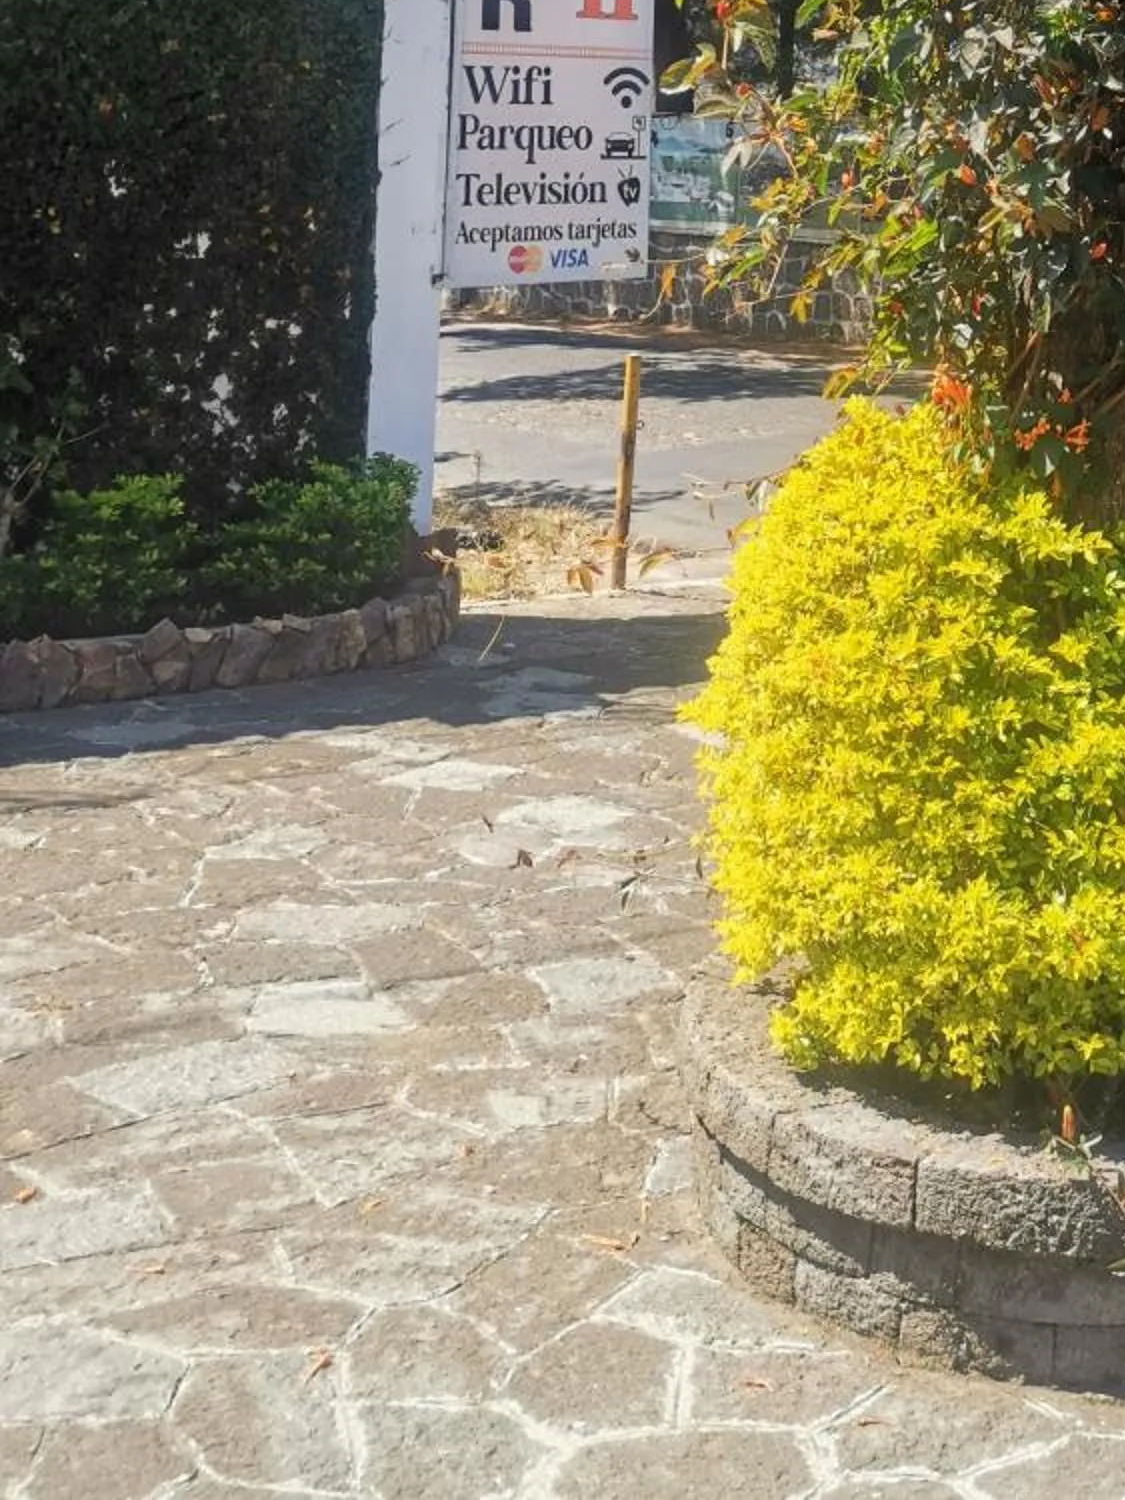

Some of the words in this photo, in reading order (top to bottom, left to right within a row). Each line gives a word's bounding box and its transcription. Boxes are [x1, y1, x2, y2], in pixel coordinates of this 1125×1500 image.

[462, 65, 554, 105] Wifi
[456, 114, 593, 164] Parqueo
[456, 172, 608, 206] Televisión
[455, 220, 563, 252] Aceptamos
[568, 218, 637, 248] tarjetas
[550, 249, 589, 268] VISA
